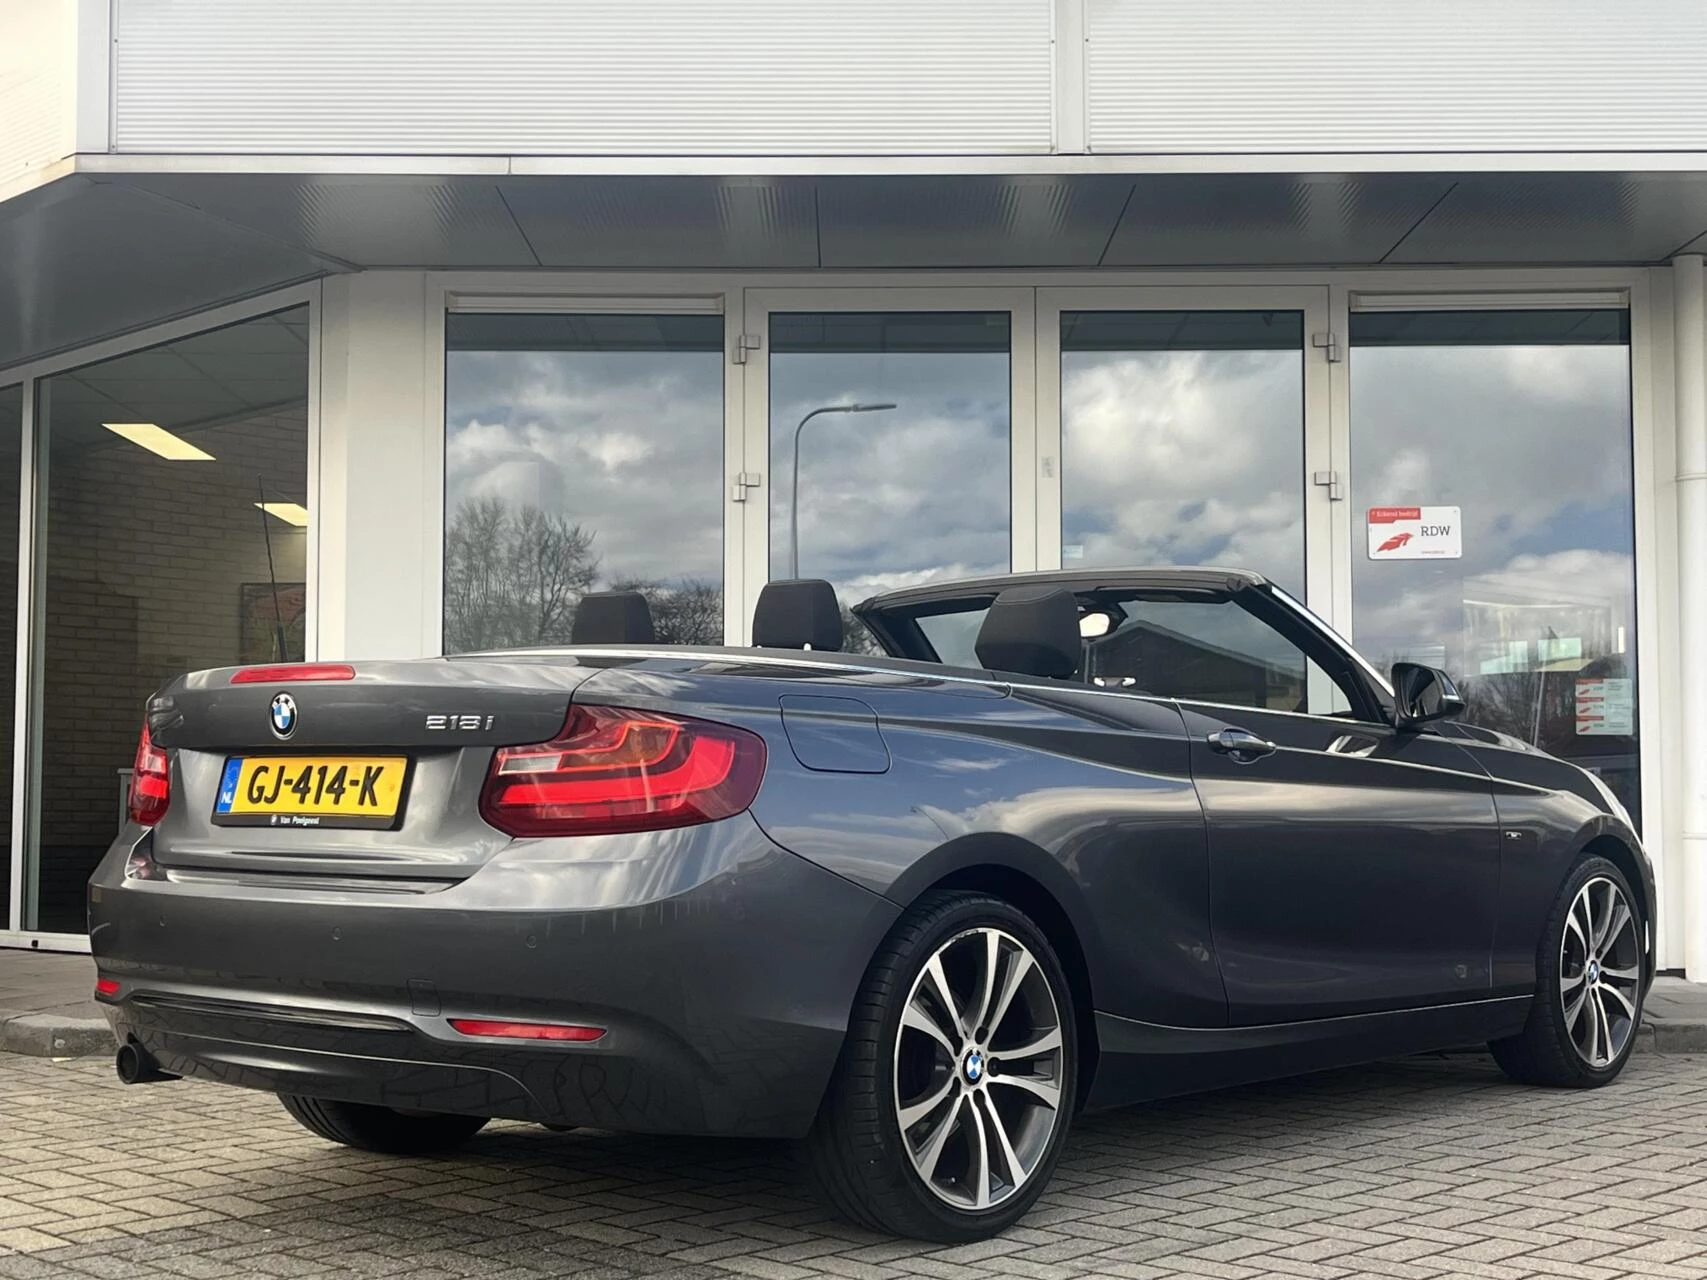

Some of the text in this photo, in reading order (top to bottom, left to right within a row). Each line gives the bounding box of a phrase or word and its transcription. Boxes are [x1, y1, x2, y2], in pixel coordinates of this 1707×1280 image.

[1421, 525, 1450, 536] RDW
[426, 715, 495, 730] 218i
[247, 765, 384, 806] GJ-414-K
[220, 791, 233, 805] NL
